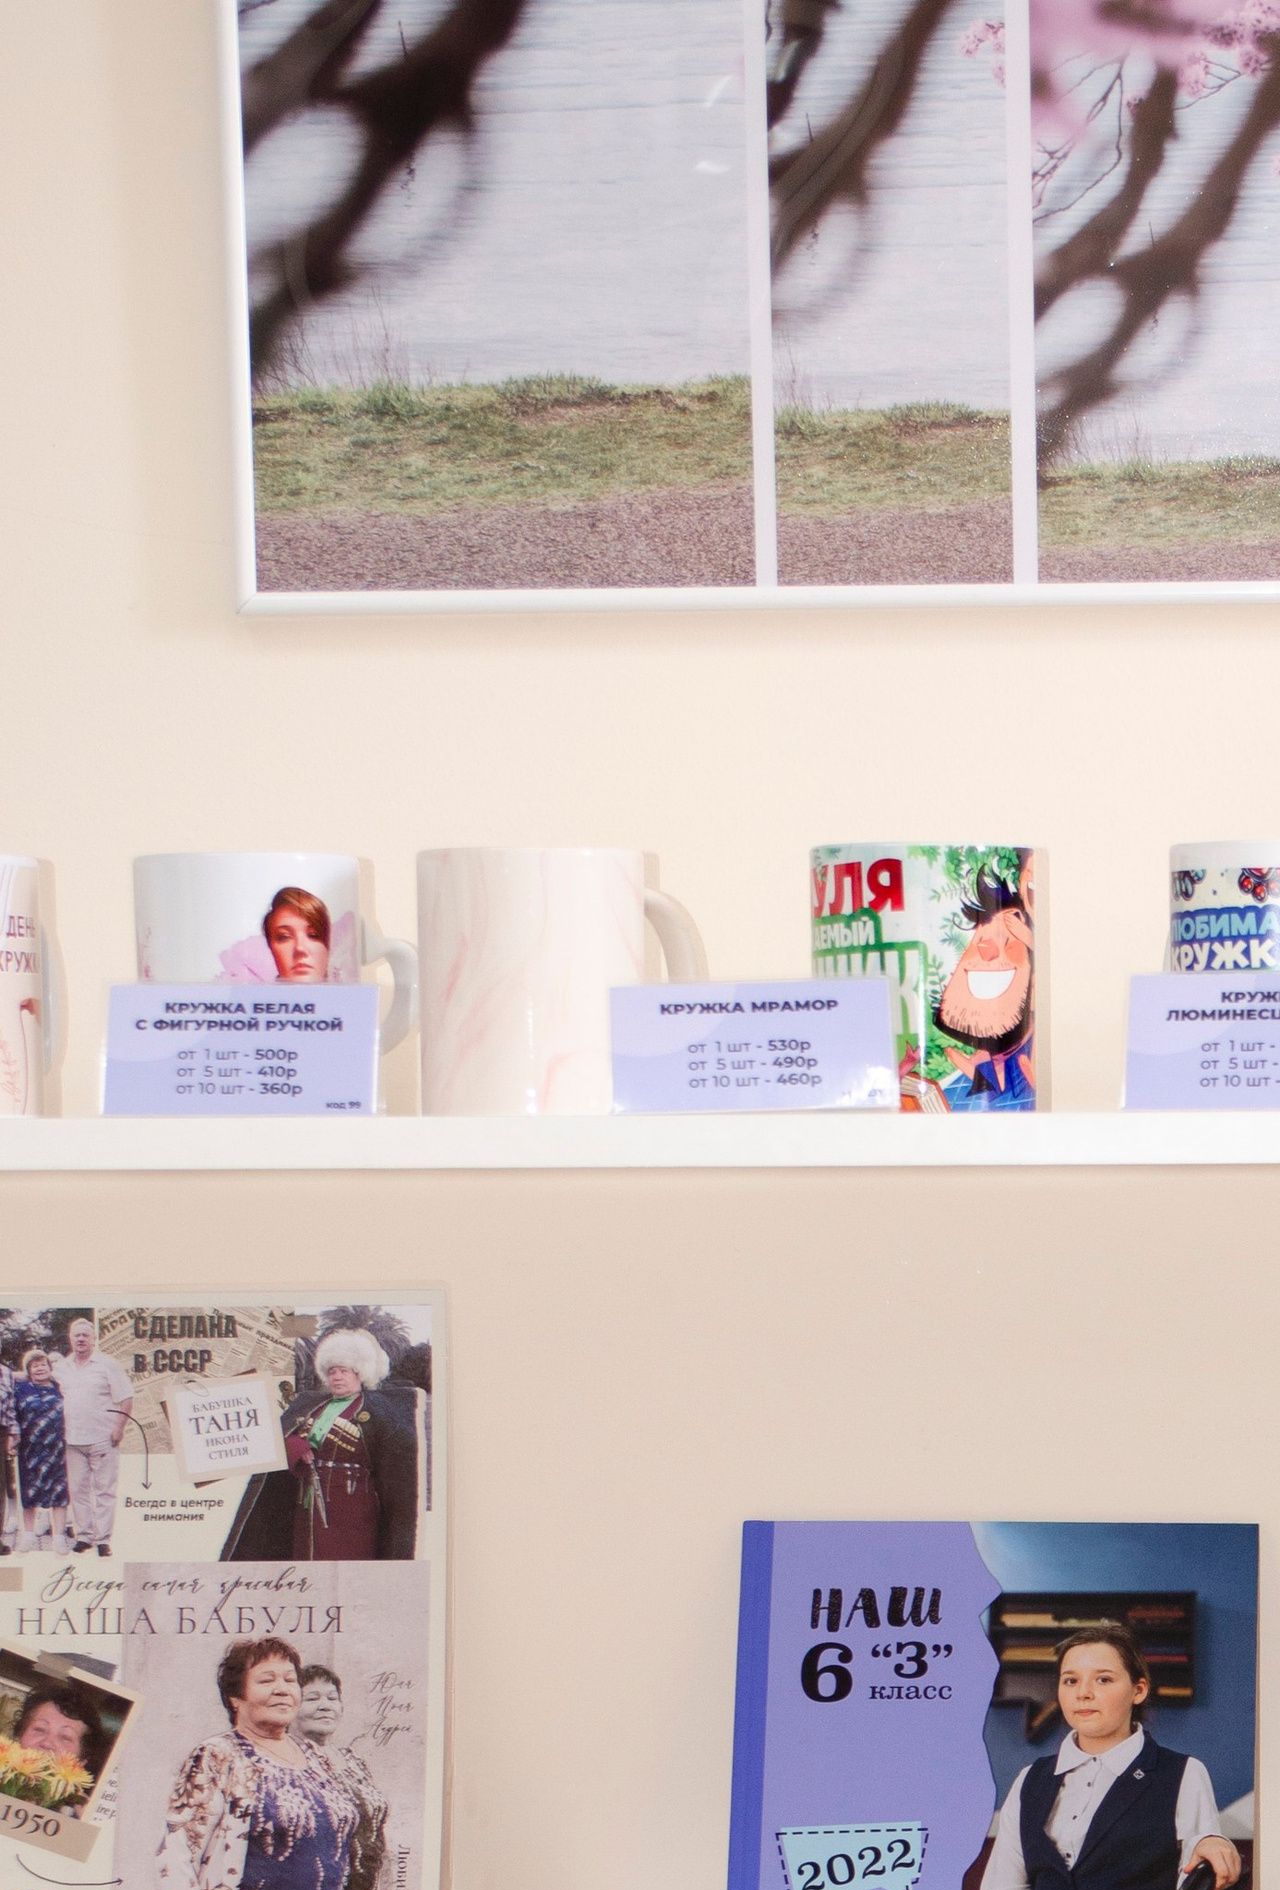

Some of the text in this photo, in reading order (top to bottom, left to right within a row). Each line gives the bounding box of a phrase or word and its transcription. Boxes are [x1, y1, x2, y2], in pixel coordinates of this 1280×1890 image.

[165, 1002, 316, 1015] КРУЖКА БЕЛАЯ
[660, 998, 839, 1016] КРУЖКА МРАМОР
[135, 1016, 343, 1032] С ФИГУРНОЙ РУЧКОЙ
[254, 1048, 299, 1063] 500р
[767, 1039, 812, 1055] 530р
[772, 1056, 818, 1072] 490р
[257, 1065, 298, 1081] 410р
[776, 1072, 823, 1089] 460р
[259, 1082, 303, 1099] 360р
[134, 1315, 239, 1342] СДЕЛАНА
[153, 1349, 213, 1373] СССР
[192, 1396, 253, 1414] БАБУШКА
[189, 1408, 261, 1435] ТАНЯ
[205, 1434, 250, 1448] ИКОНА
[208, 1447, 249, 1460] СТИЛЯ
[125, 1496, 224, 1511] Всегда в центре
[143, 1512, 205, 1522] внимания
[809, 1586, 944, 1633] НАШ
[16, 1605, 345, 1636] НАША БАБУЛЯ
[800, 1641, 853, 1703] 6
[867, 1682, 953, 1700] класс
